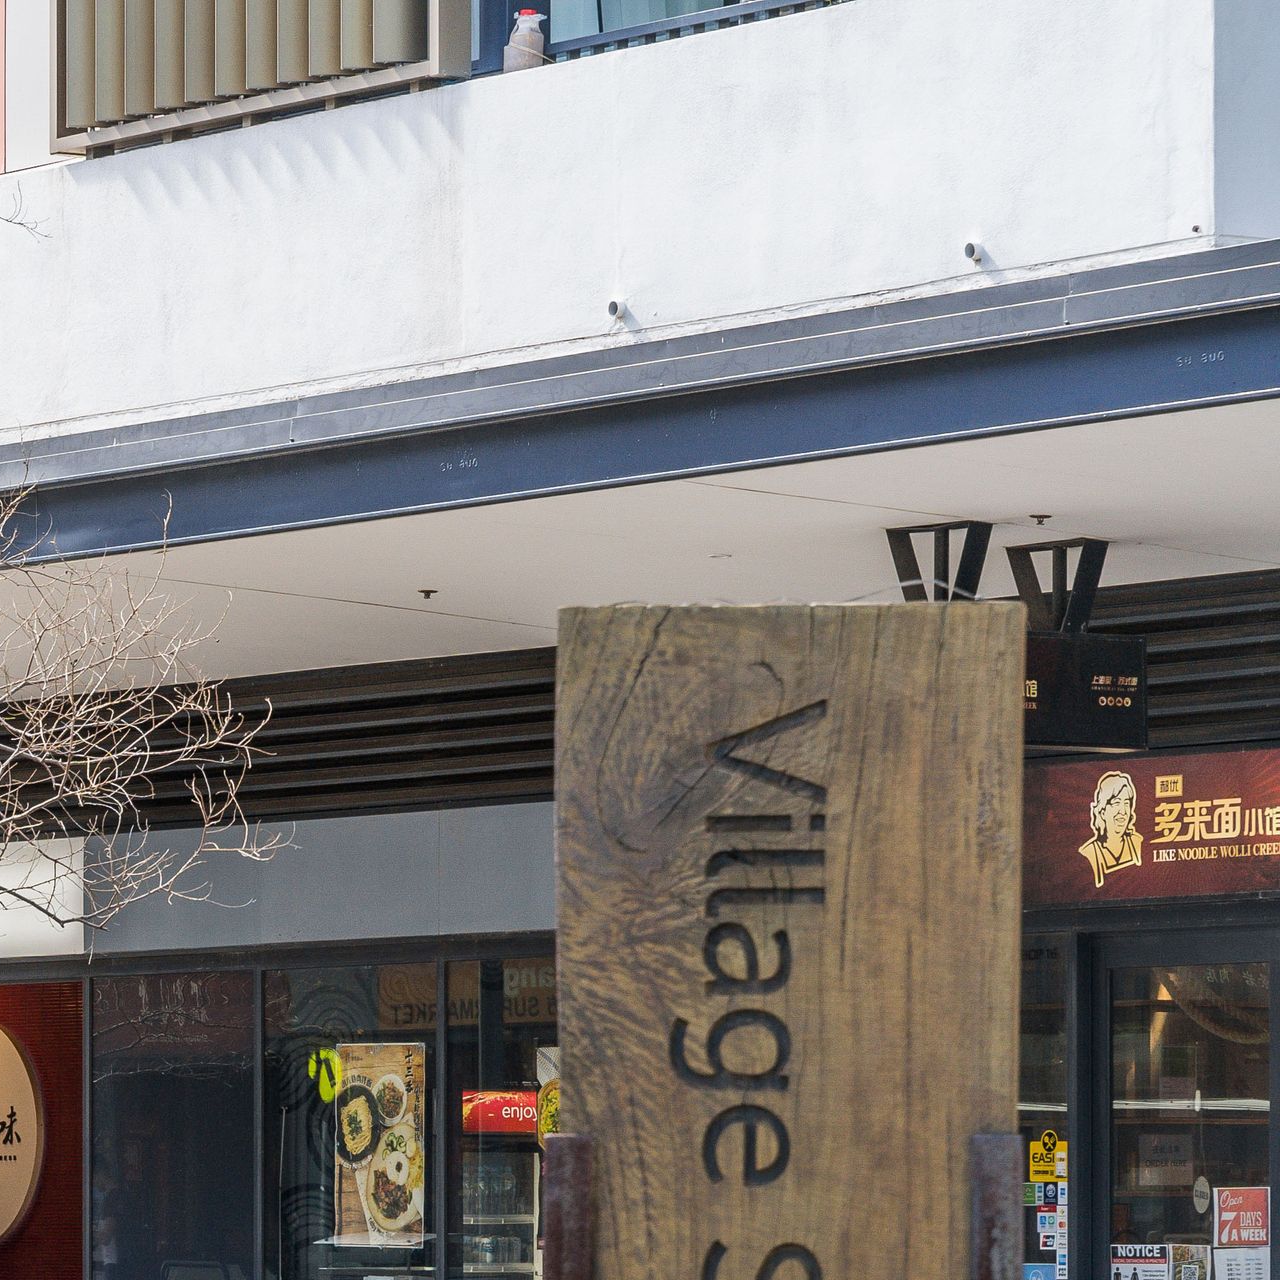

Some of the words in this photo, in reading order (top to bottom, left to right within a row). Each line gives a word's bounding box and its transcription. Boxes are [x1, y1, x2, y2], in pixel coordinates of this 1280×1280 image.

[1153, 849, 1176, 862] LIKE
[1177, 846, 1218, 861] NOODLE
[1220, 844, 1251, 858] WOLLI
[671, 698, 828, 1188] Village
[501, 1104, 538, 1121] enjoy
[1032, 1152, 1055, 1163] EASI
[1220, 1190, 1243, 1208] Open
[1221, 1212, 1237, 1243] 7
[1240, 1211, 1262, 1227] DAYS
[1231, 1229, 1239, 1241] A
[1241, 1229, 1267, 1241] WEEK
[1117, 1246, 1161, 1257] NOTICE
